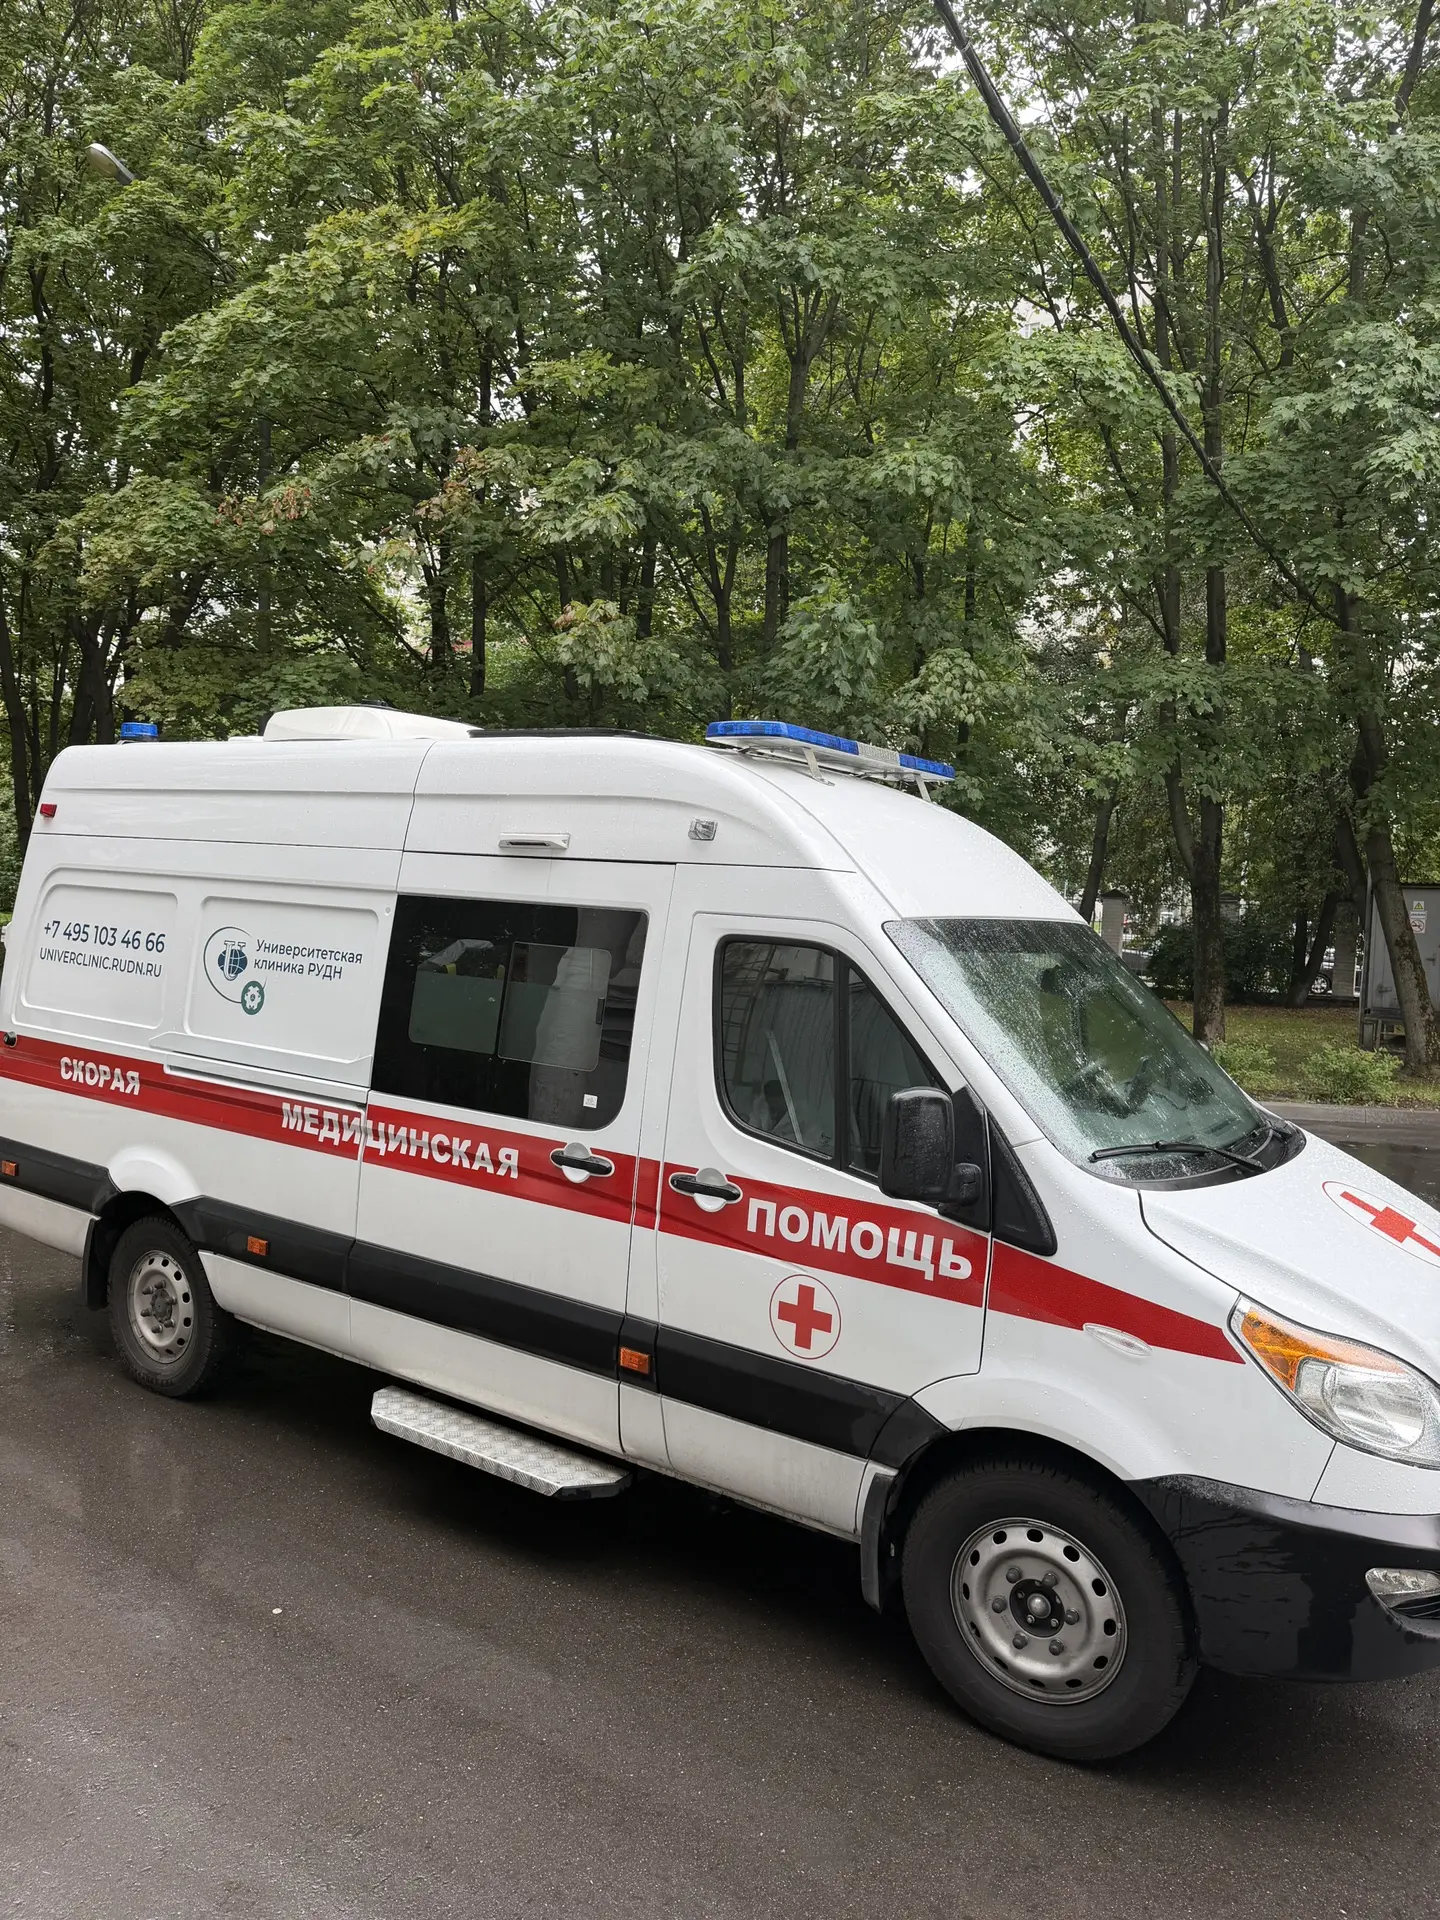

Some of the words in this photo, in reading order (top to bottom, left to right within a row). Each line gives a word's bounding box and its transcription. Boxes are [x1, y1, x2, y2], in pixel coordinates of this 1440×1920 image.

[44, 920, 61, 938] +7
[63, 921, 90, 943] 495
[93, 925, 118, 946] 103
[120, 929, 142, 950] 46
[145, 932, 166, 953] 66
[256, 938, 363, 964] Университетская
[39, 947, 162, 978] UNIVERCLINIC.RUDN.RU
[253, 958, 304, 975] клиника
[307, 962, 343, 981] РУДН
[60, 1056, 140, 1095] СКОРАЯ
[281, 1102, 519, 1179] МЕДИЦИНСКАЯ
[746, 1198, 973, 1280] ПОМОЩЬ
